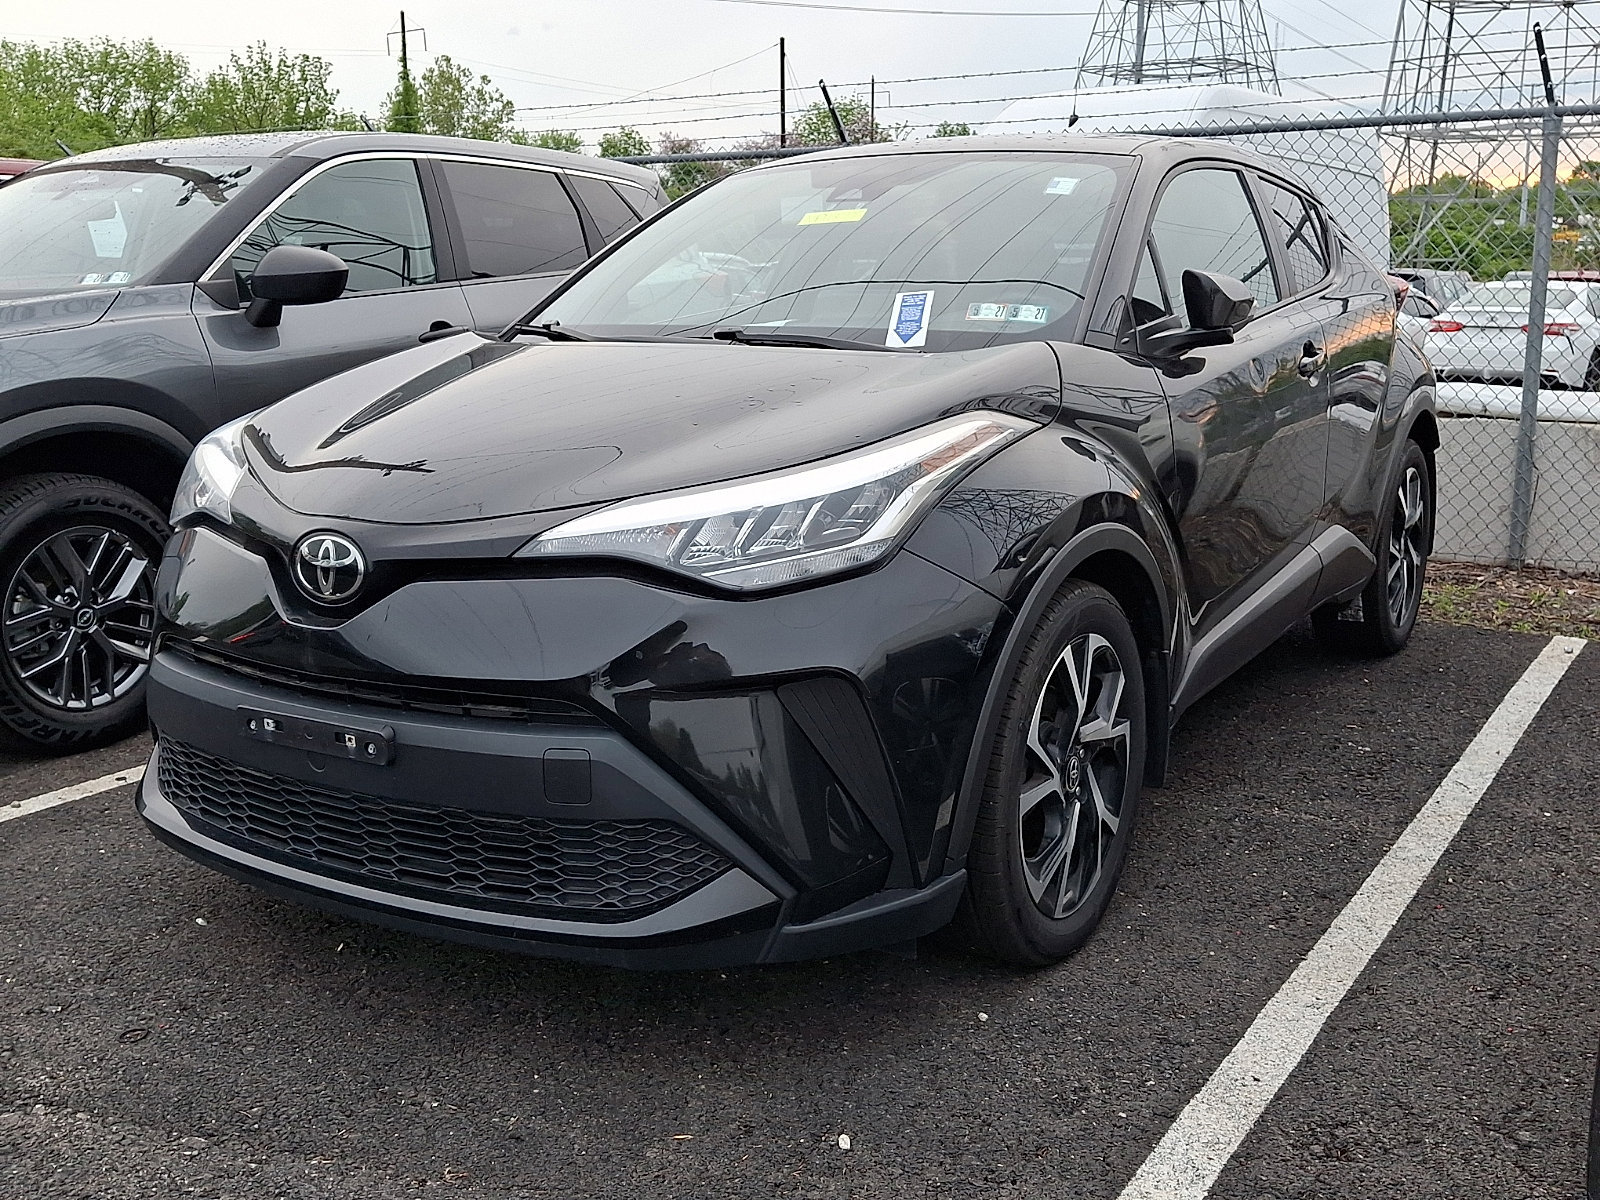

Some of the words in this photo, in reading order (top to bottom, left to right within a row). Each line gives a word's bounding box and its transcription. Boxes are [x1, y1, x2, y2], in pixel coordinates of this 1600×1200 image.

[994, 306, 1006, 318] 27
[1012, 307, 1019, 318] 5
[1034, 308, 1046, 320] 27
